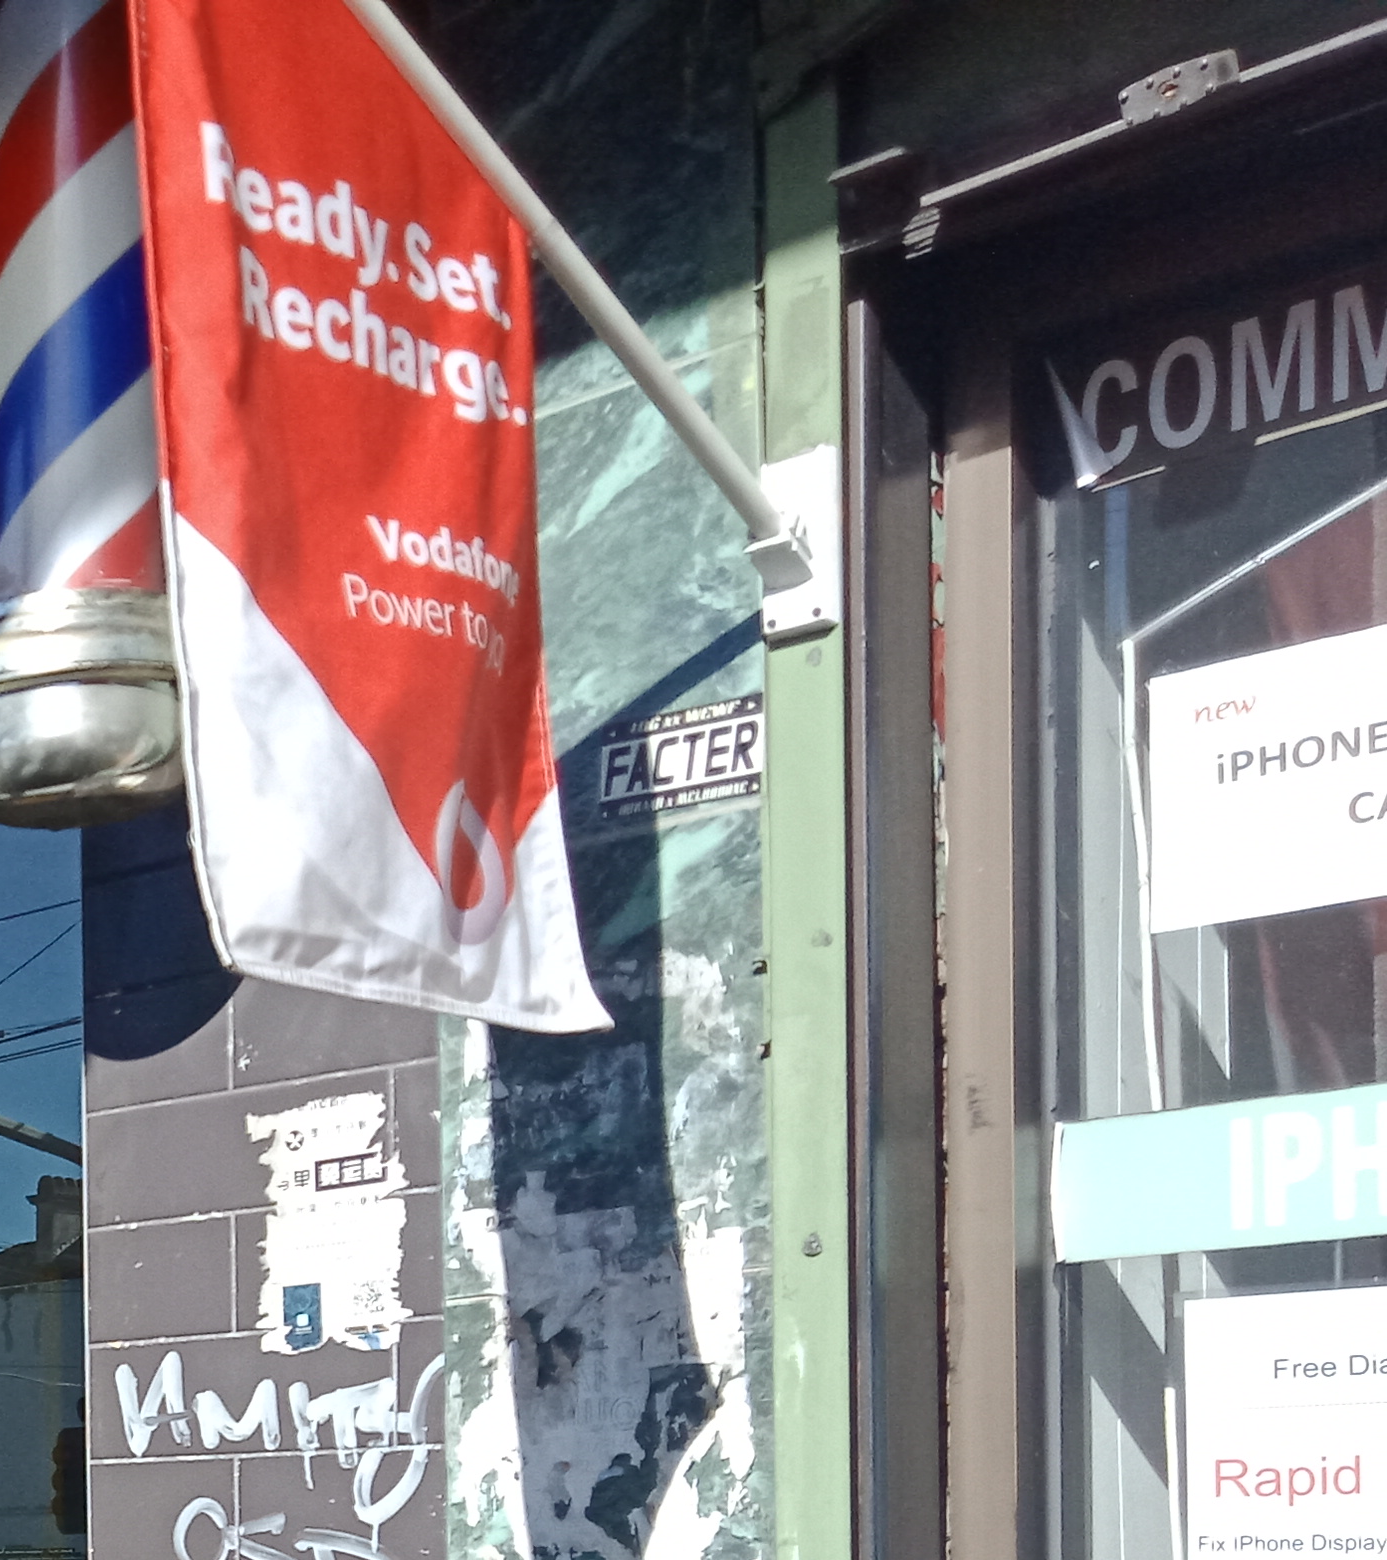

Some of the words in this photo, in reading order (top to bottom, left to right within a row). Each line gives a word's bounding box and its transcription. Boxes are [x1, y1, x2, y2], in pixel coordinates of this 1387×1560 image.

[404, 222, 511, 330] Set.
[240, 245, 527, 427] Recharge.
[367, 513, 520, 608] Vodafon
[340, 572, 456, 637] Power
[462, 601, 488, 649] to
[1194, 695, 1257, 724] new
[604, 719, 759, 799] FACTER
[1216, 720, 1387, 785] iPHONE
[1273, 1358, 1337, 1379] Free
[1214, 1455, 1361, 1507] Rapid
[1198, 1535, 1226, 1552] Fix
[1312, 1533, 1387, 1555] Display
